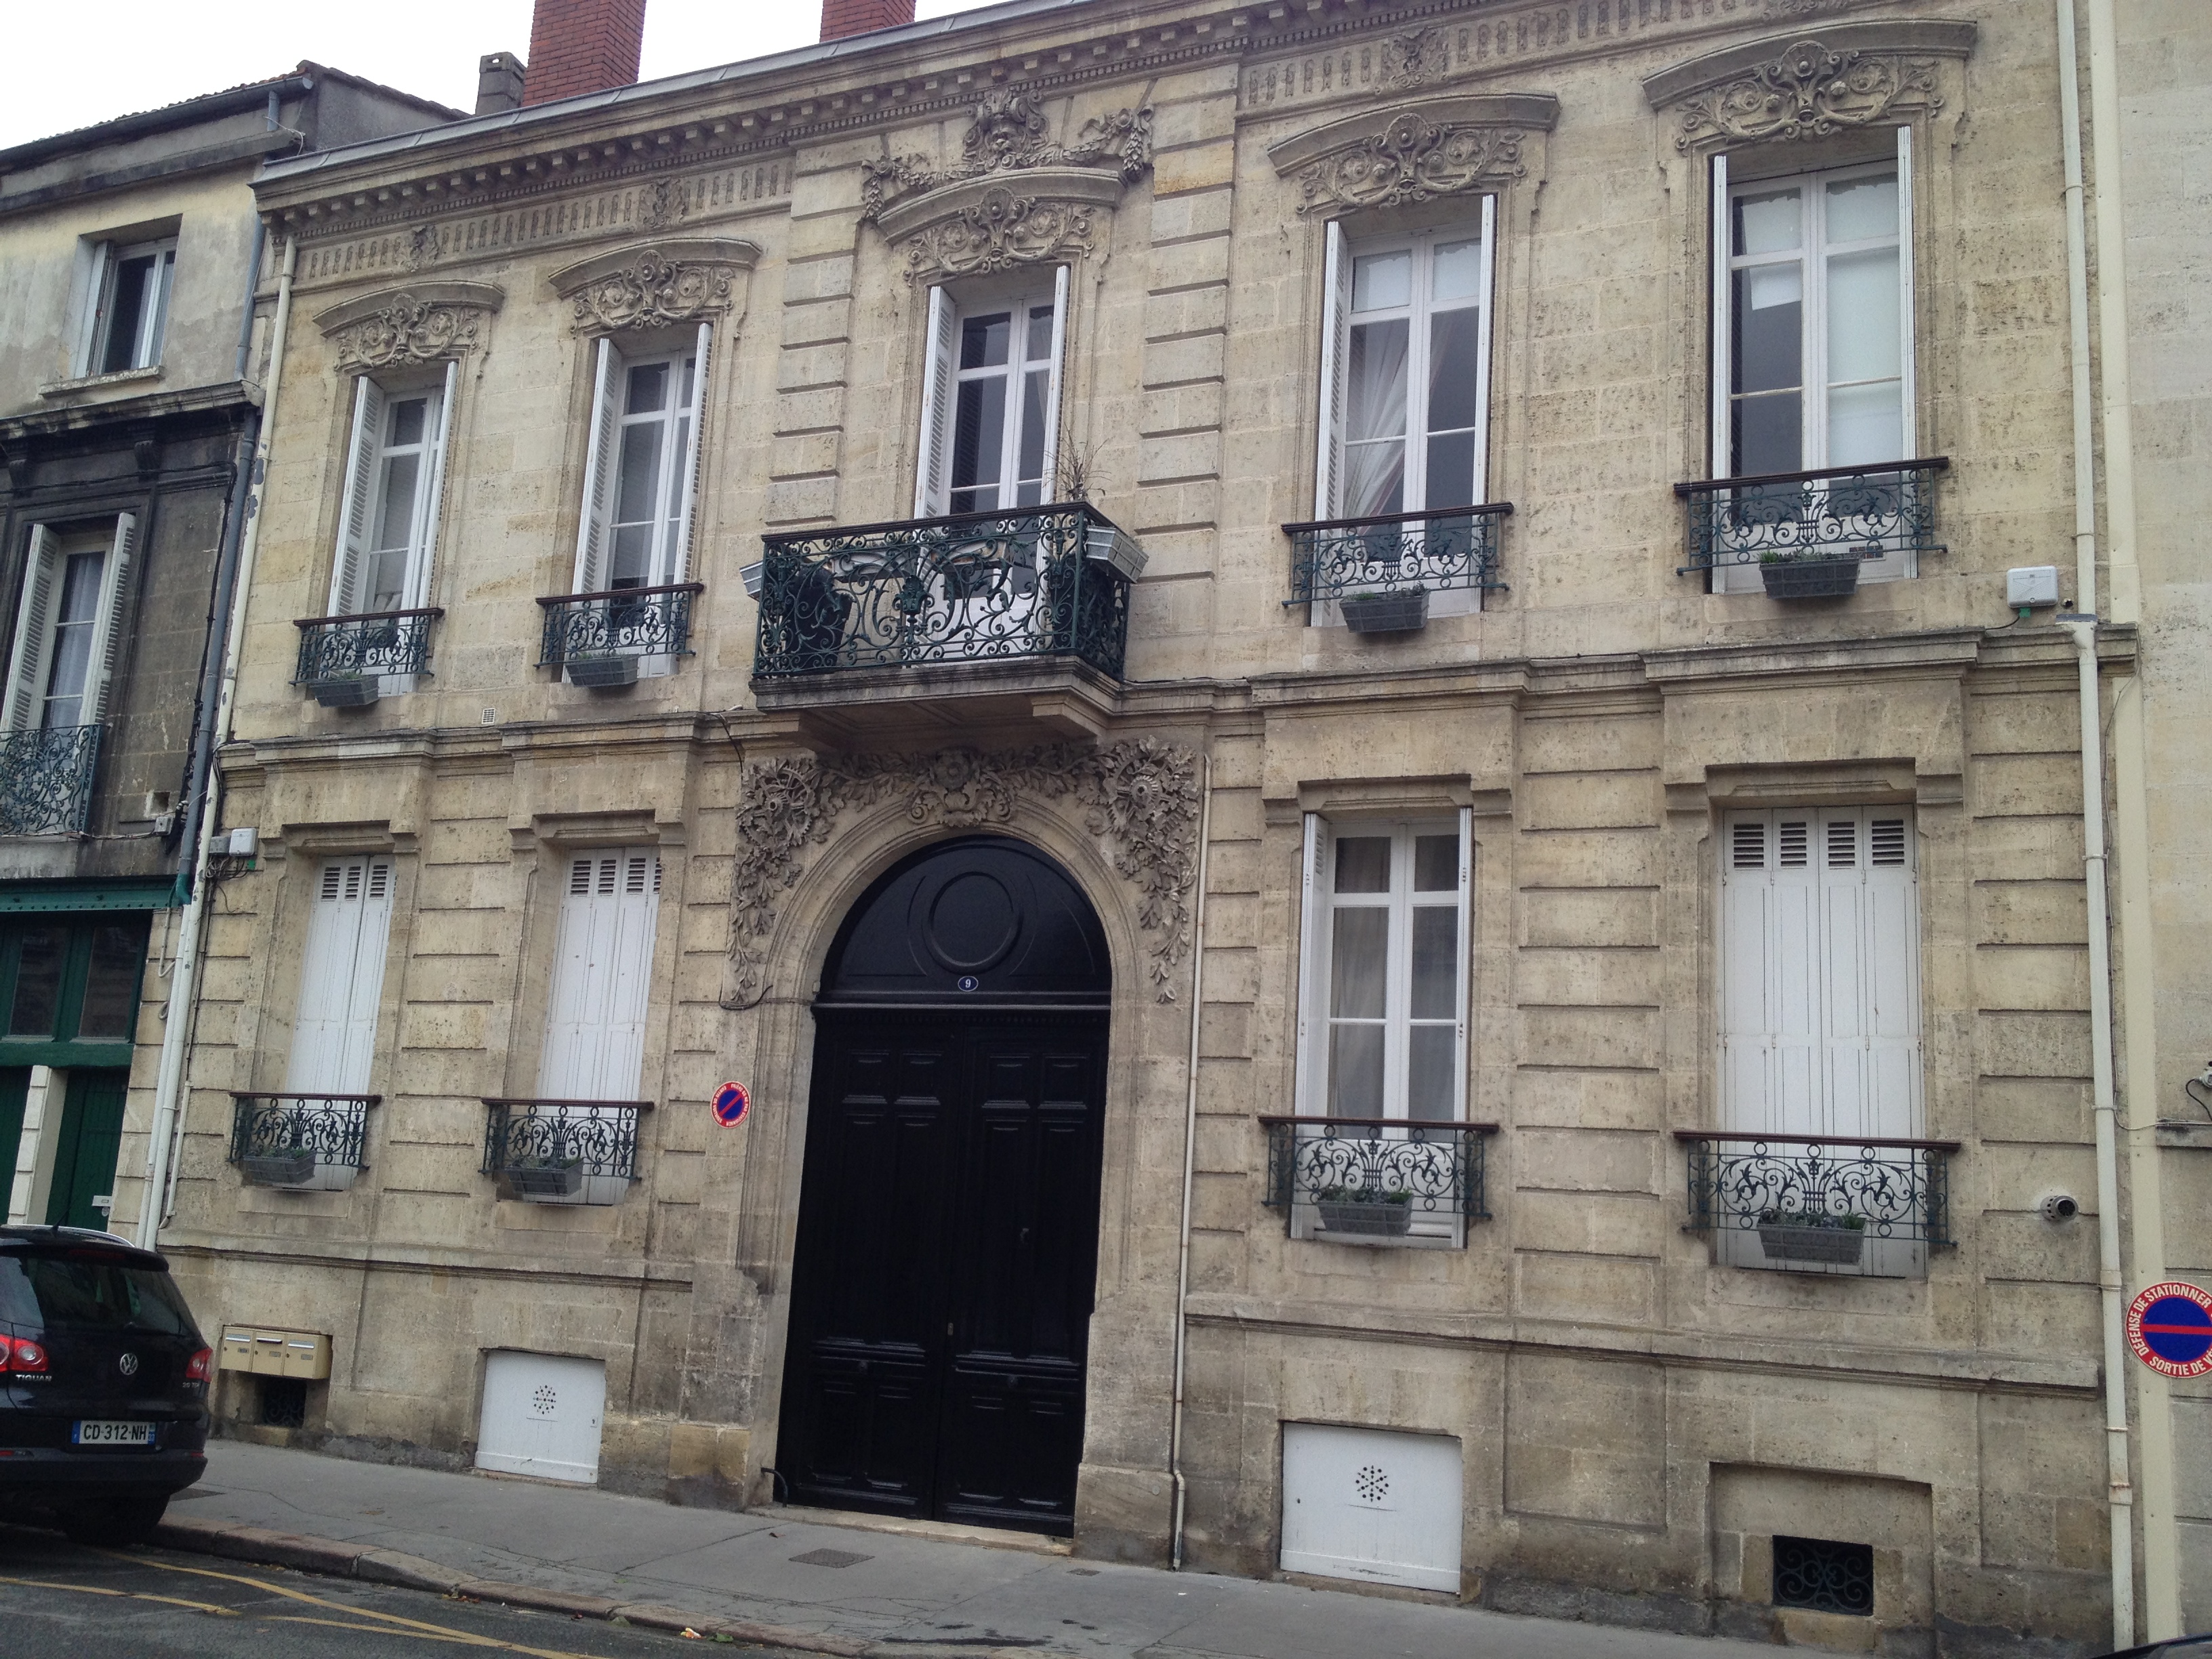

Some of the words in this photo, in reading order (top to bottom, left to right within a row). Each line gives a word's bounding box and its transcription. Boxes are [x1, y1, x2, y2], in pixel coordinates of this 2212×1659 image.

[965, 979, 971, 988] 9
[2133, 1297, 2149, 1313] DE
[2144, 1284, 2211, 1309] STATIONNER
[2129, 1311, 2150, 1356] DEFENSE
[2149, 1357, 2190, 1375] SORTIE
[2190, 1360, 2207, 1374] DE
